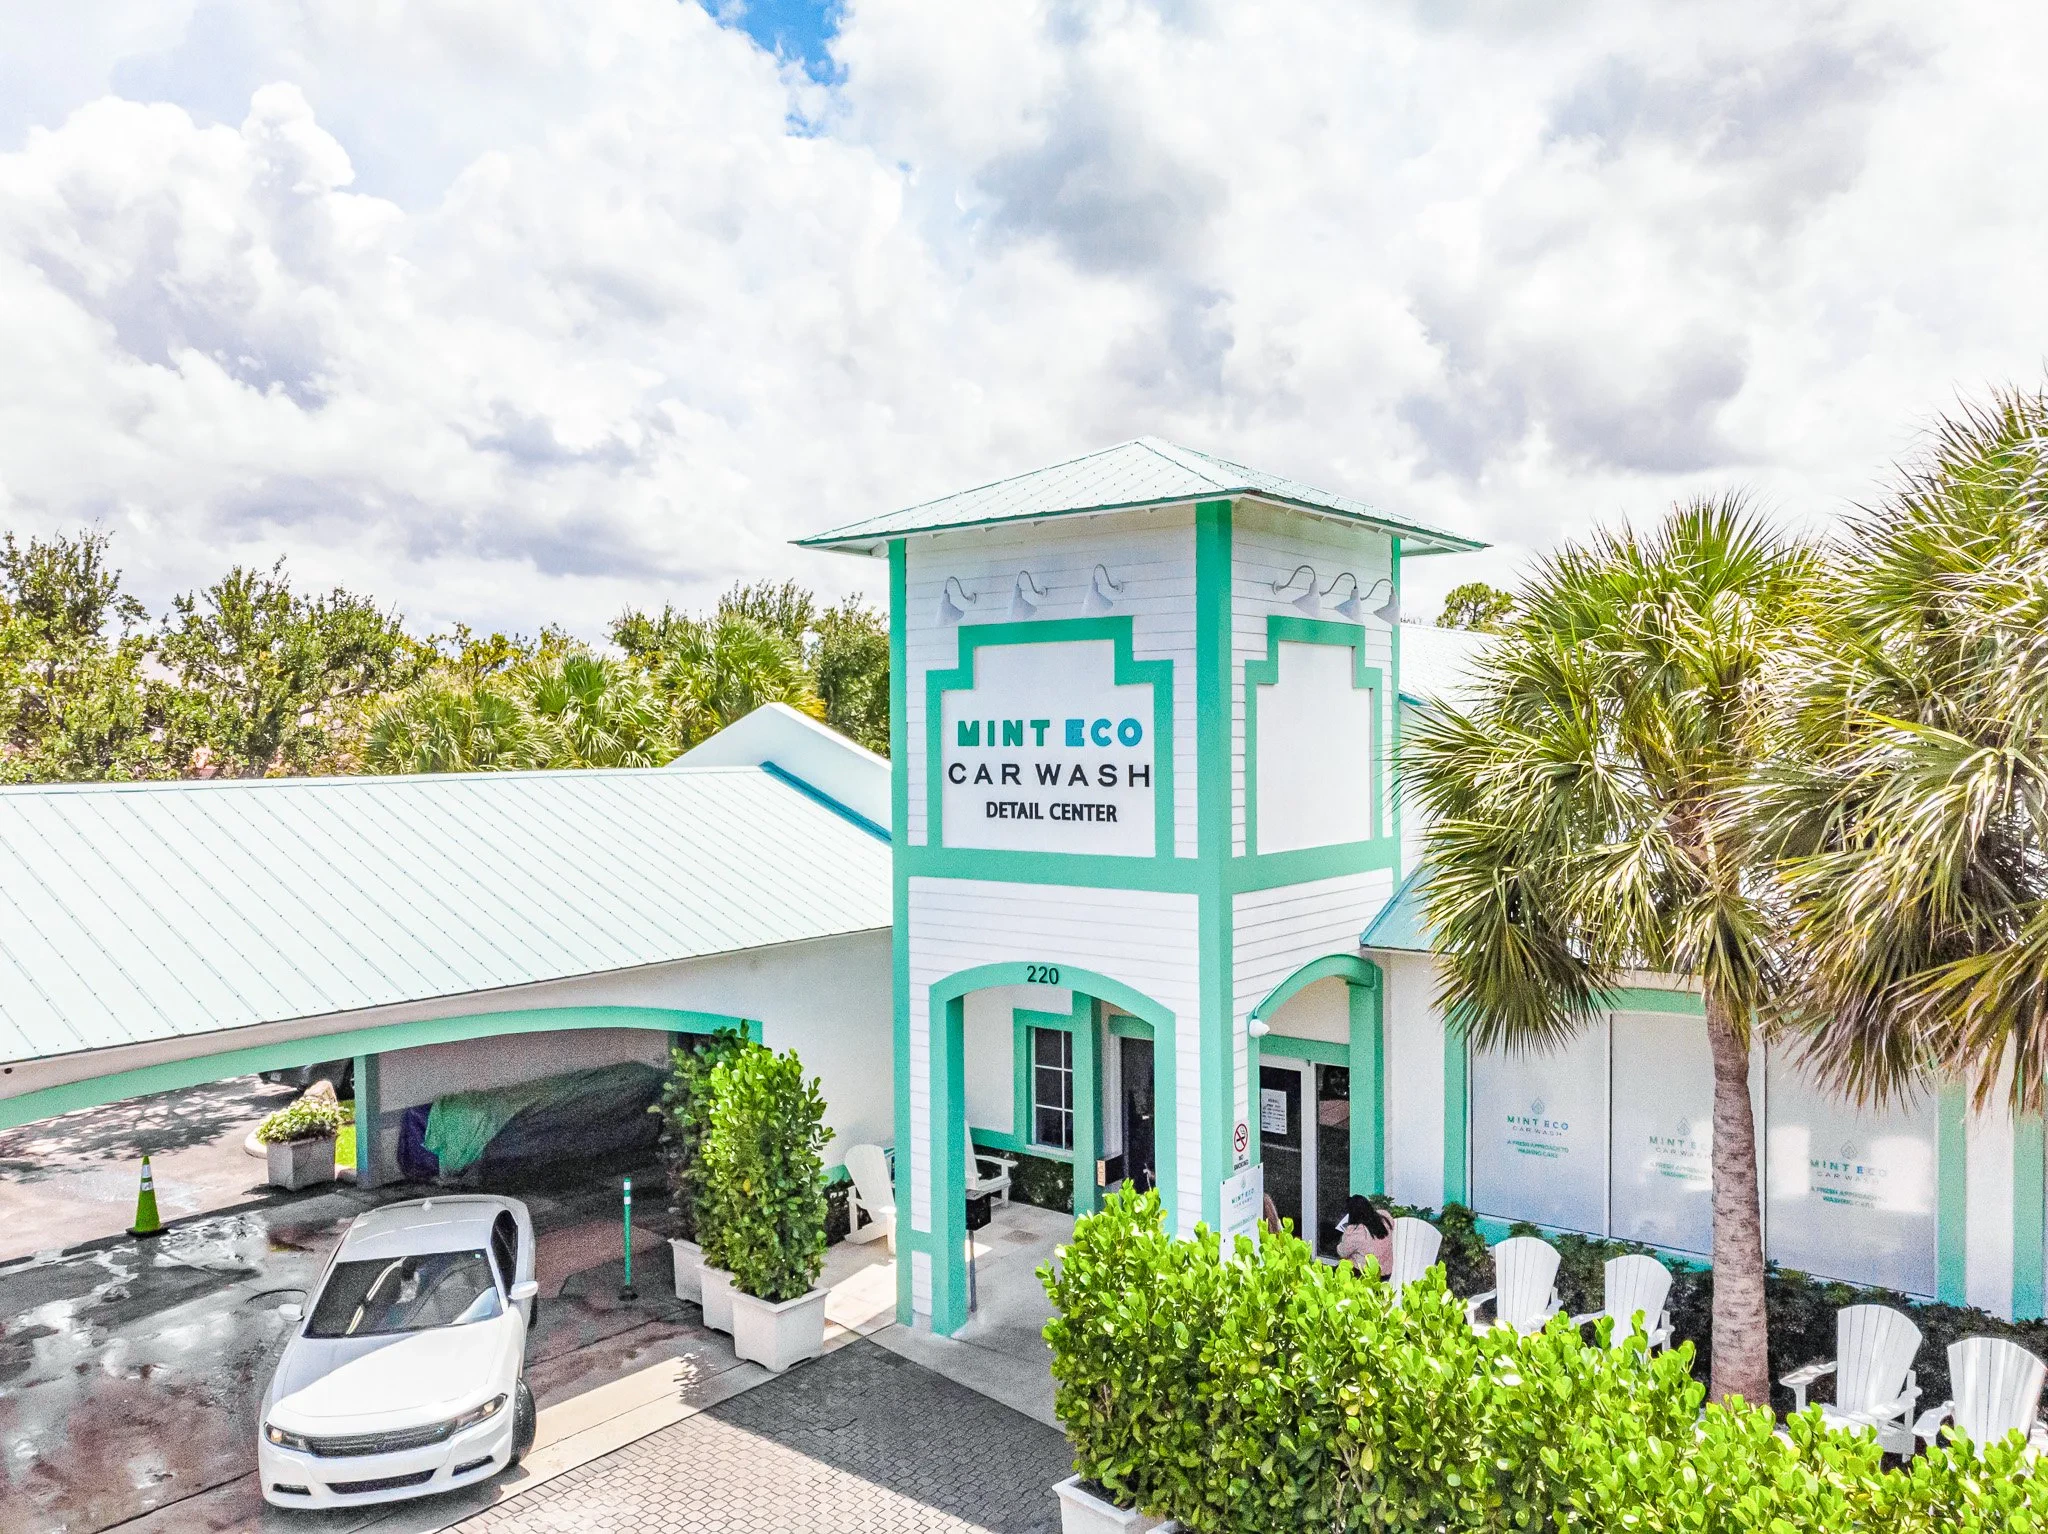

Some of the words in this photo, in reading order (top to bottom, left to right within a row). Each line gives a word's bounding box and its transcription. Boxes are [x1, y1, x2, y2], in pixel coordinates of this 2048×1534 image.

[957, 718, 1051, 748] MINT
[1065, 717, 1143, 748] ECO
[948, 762, 1022, 785] CAR
[1035, 763, 1150, 788] WASH
[985, 801, 1044, 820] DETAIL
[1049, 803, 1118, 823] CENTER
[1026, 965, 1060, 985] 220
[1506, 1115, 1538, 1126] MINT
[1544, 1120, 1569, 1131] ECO
[1534, 1128, 1562, 1137] WASH
[1649, 1135, 1685, 1147] MINT
[1809, 1159, 1850, 1172] MINT
[1856, 1165, 1888, 1178] ECO
[1816, 1171, 1841, 1179] CAR
